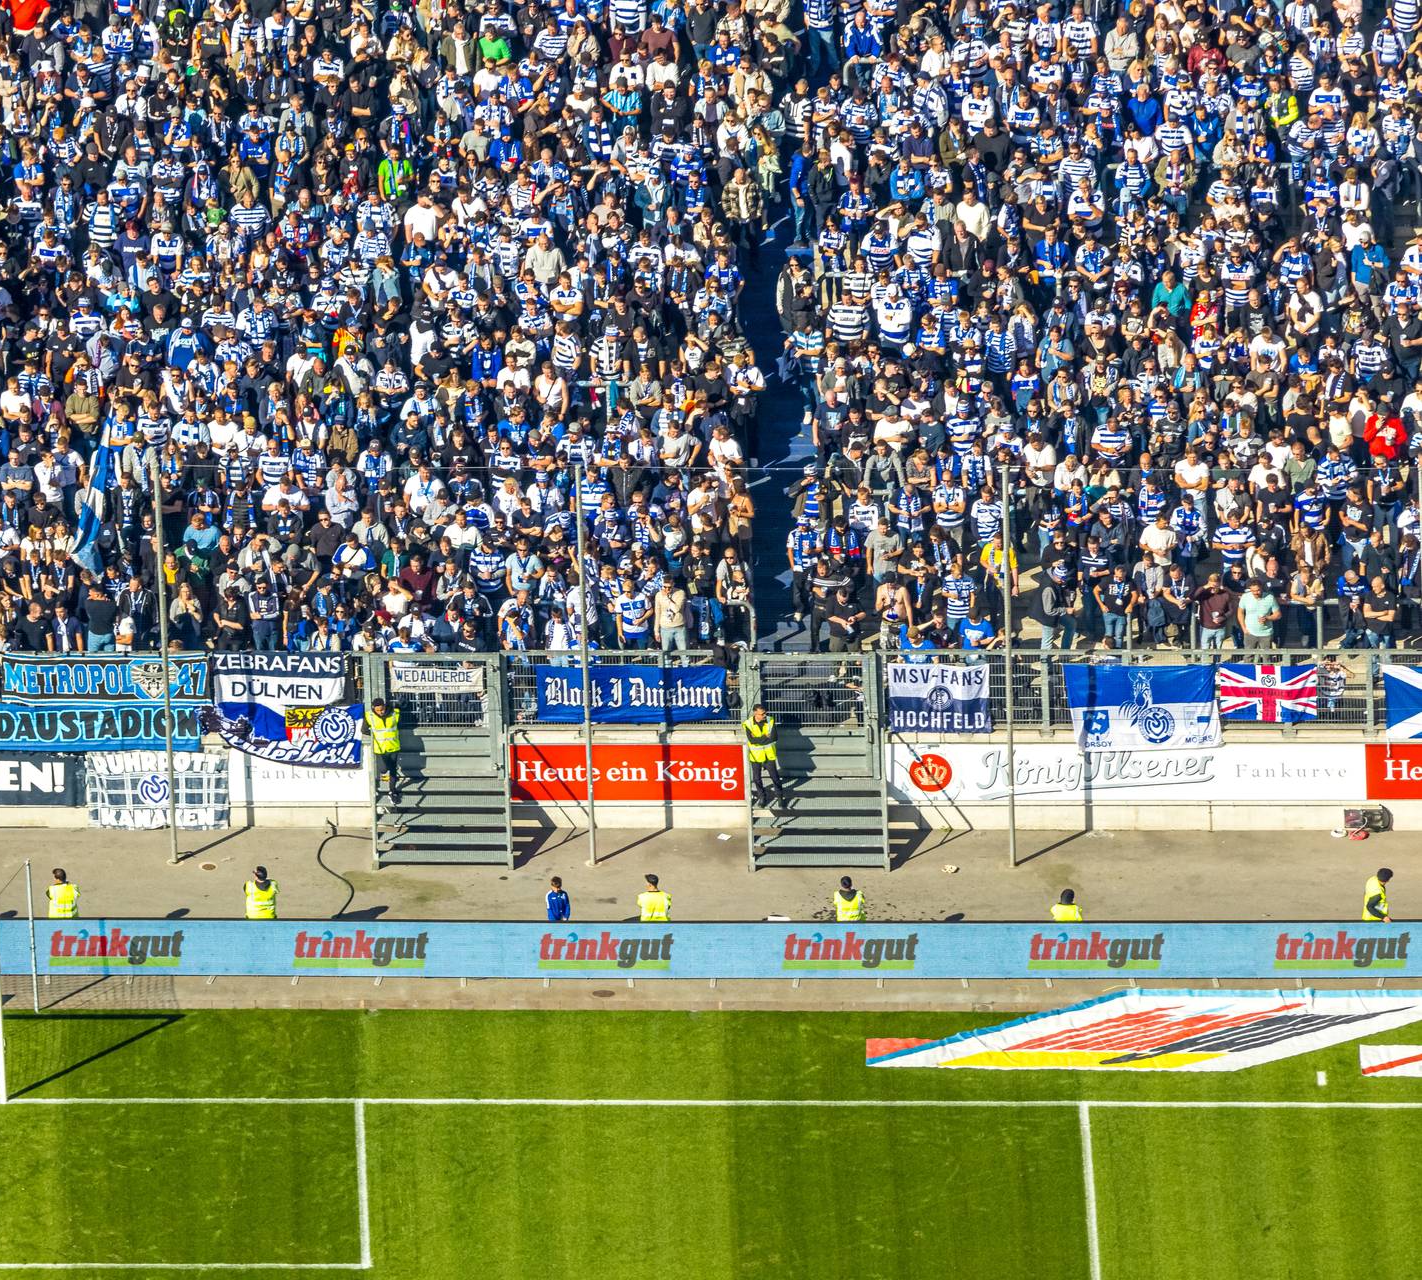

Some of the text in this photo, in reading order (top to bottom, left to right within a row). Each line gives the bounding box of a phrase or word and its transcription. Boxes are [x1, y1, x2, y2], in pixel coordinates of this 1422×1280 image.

[3, 661, 208, 695] METROPOL 47
[213, 653, 341, 673] ZEBRAFANS
[394, 669, 473, 682] WEDAUHERDE
[893, 668, 983, 687] MSV-FANS
[231, 679, 322, 700] DÜLMEN
[629, 677, 723, 713] Duisburg
[893, 710, 986, 730] HOCHFELD
[246, 765, 357, 780] Fankurve
[516, 760, 738, 791] Heute ein König
[1236, 763, 1347, 778] Fankurve
[50, 928, 185, 965] trinkgut
[293, 929, 429, 966] trinkgut
[539, 931, 674, 968] trinkgut
[784, 931, 918, 968] trinkgut
[1028, 931, 1165, 968] trinkgut
[1275, 931, 1411, 967] trinkgut
